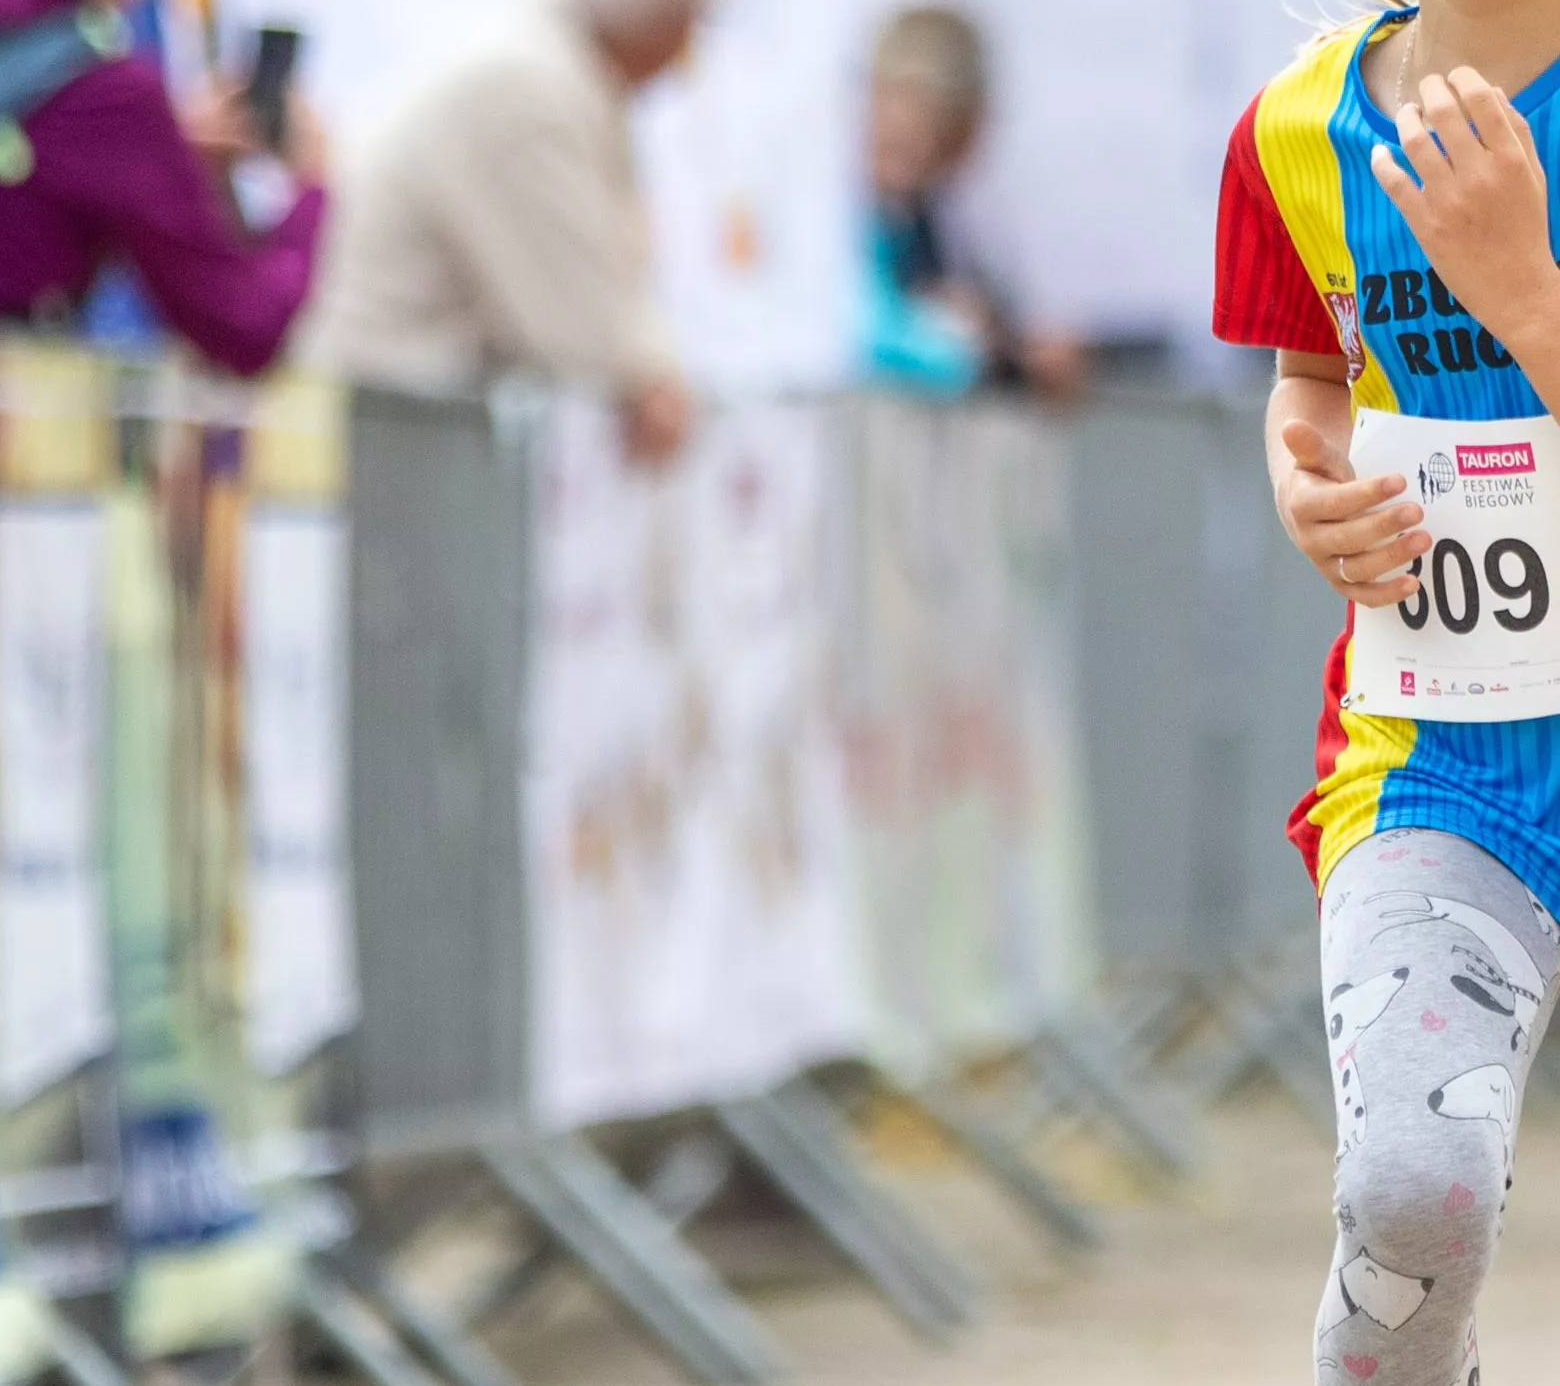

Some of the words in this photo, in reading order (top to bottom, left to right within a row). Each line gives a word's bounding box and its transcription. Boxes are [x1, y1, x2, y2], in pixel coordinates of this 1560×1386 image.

[1396, 327, 1523, 376] RUC
[1458, 449, 1529, 470] TAURON
[1462, 477, 1534, 493] FESTIWAL
[1464, 492, 1535, 509] BIEGOWY
